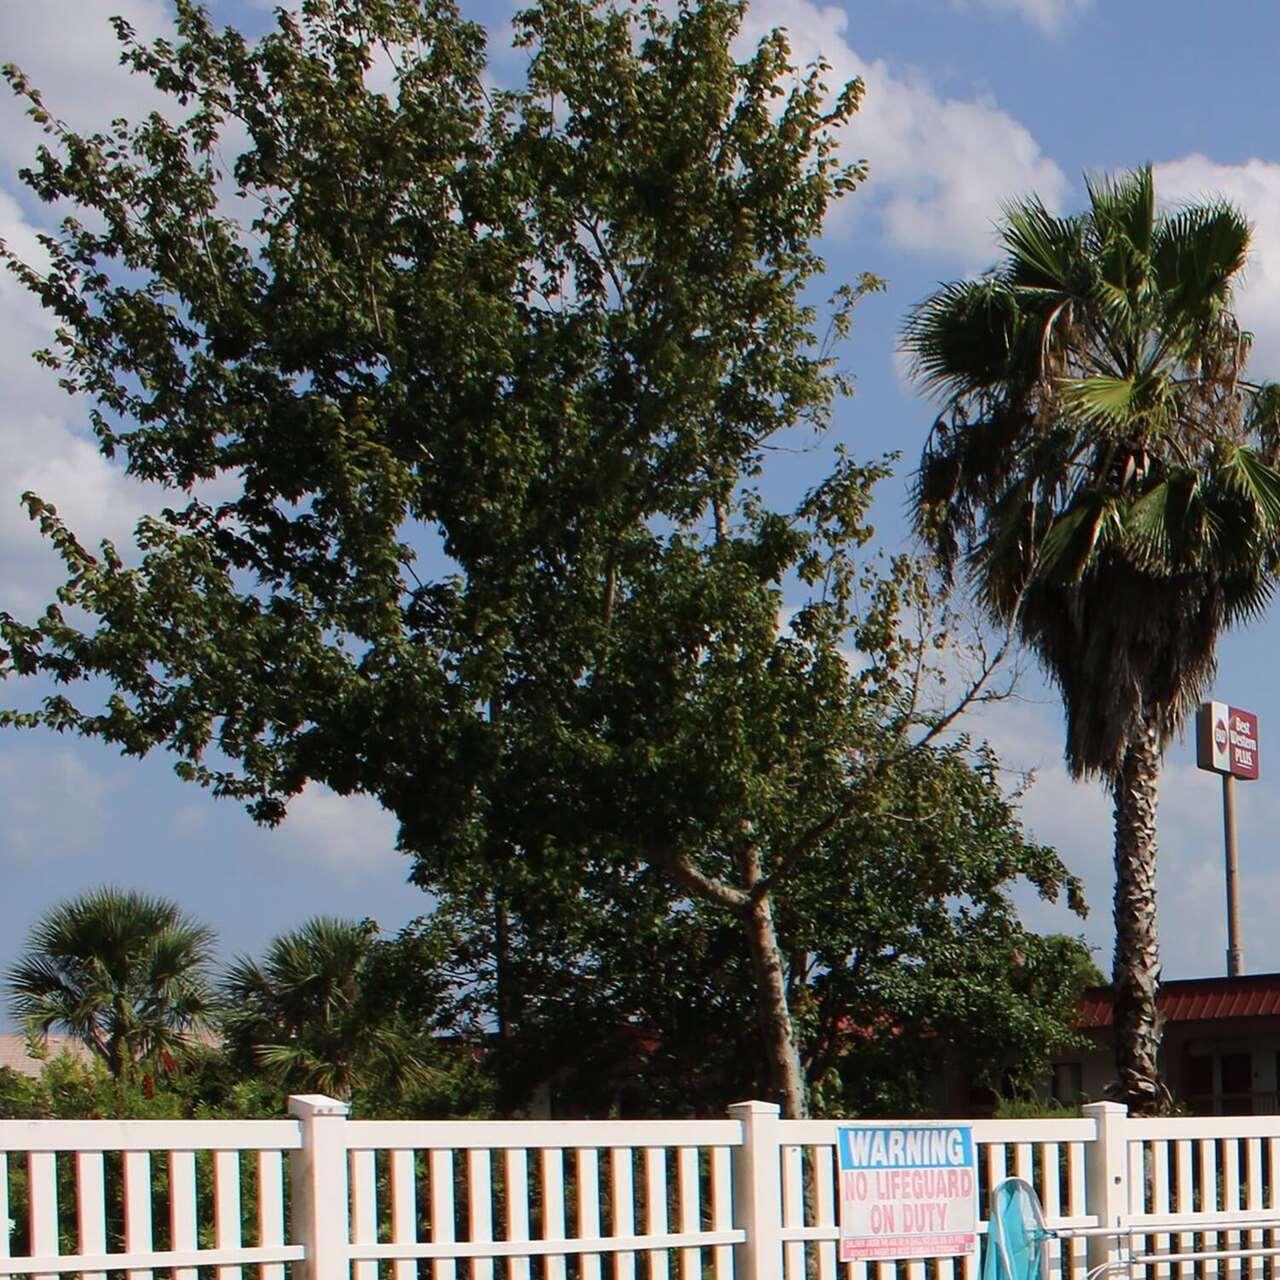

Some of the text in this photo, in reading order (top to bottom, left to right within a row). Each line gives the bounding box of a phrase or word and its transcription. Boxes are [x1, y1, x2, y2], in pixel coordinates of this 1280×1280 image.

[848, 1129, 965, 1166] WARNING
[845, 1169, 972, 1201] NO LIFEGUARD
[871, 1203, 948, 1234] ON DUTY
